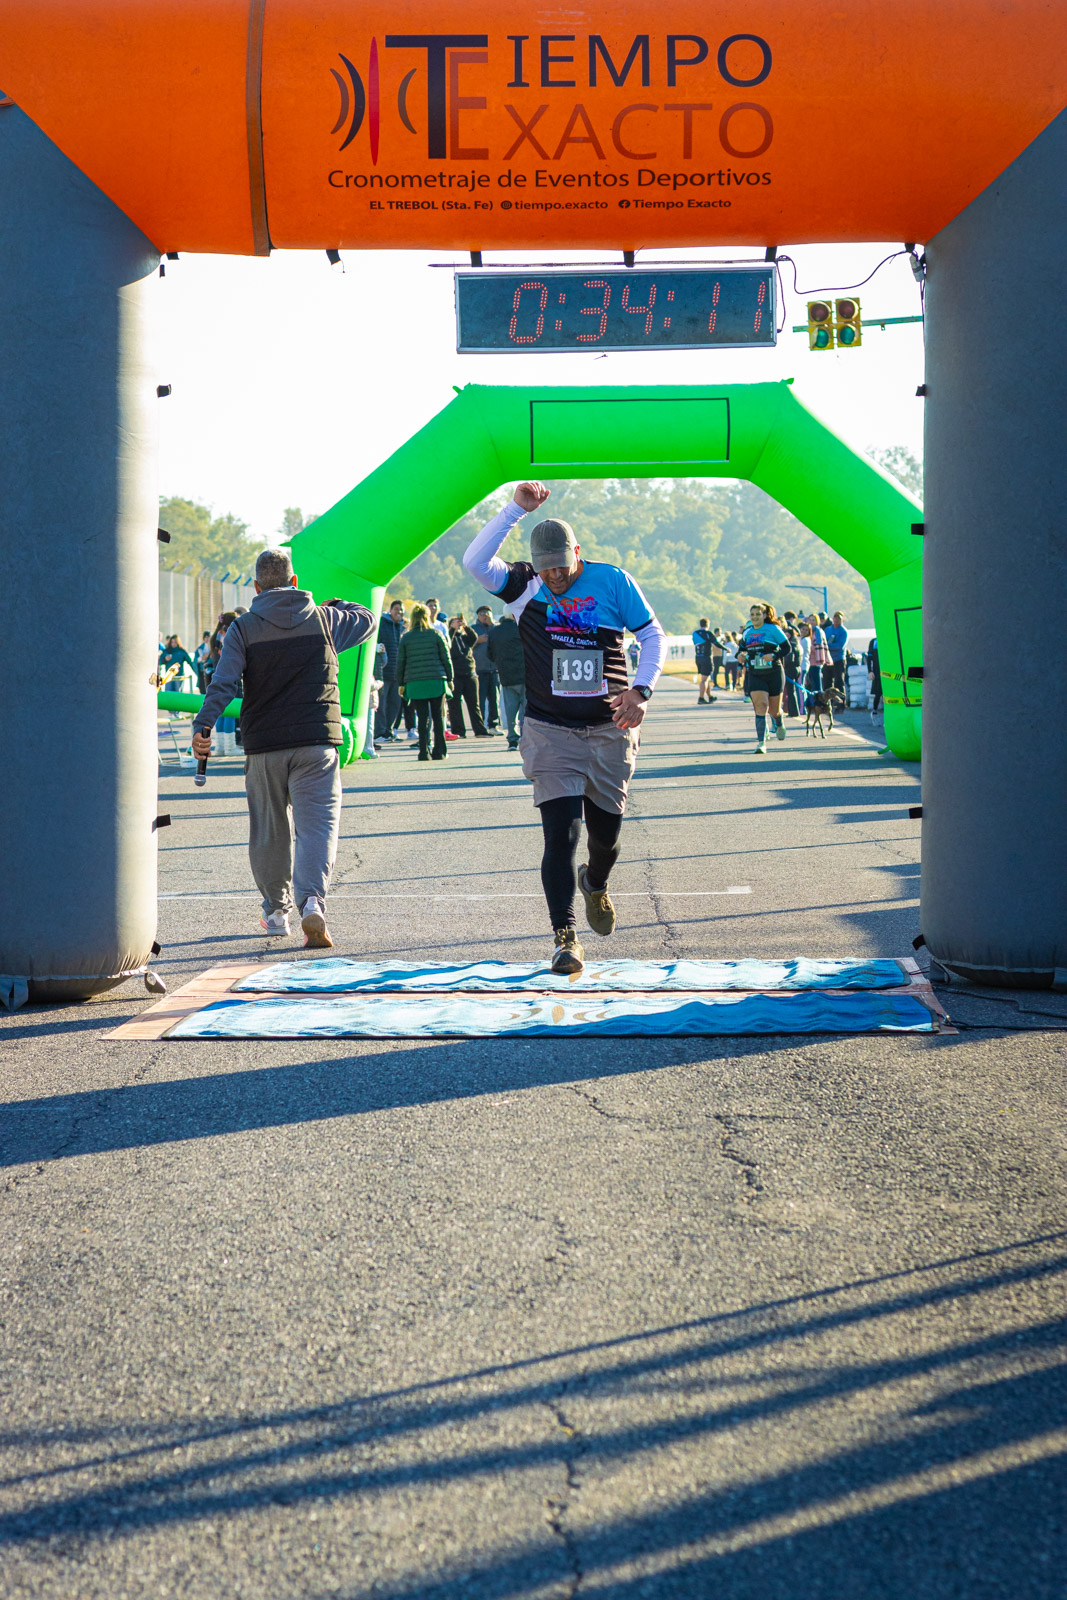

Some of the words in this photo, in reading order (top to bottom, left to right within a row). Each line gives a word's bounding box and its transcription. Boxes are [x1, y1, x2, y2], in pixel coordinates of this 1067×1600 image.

[328, 170, 491, 192] Cronometraje
[497, 169, 527, 188] de
[534, 169, 630, 188] Eventos
[637, 168, 772, 191] Deportivos
[369, 200, 385, 211] EL
[387, 200, 438, 210] TREBOL
[441, 200, 471, 211] (Sta.
[474, 200, 494, 211] Fe)
[514, 200, 609, 212] tiempo.exacto
[632, 199, 684, 210] Tiempo
[687, 199, 732, 209] Exacto
[562, 659, 594, 682] 139
